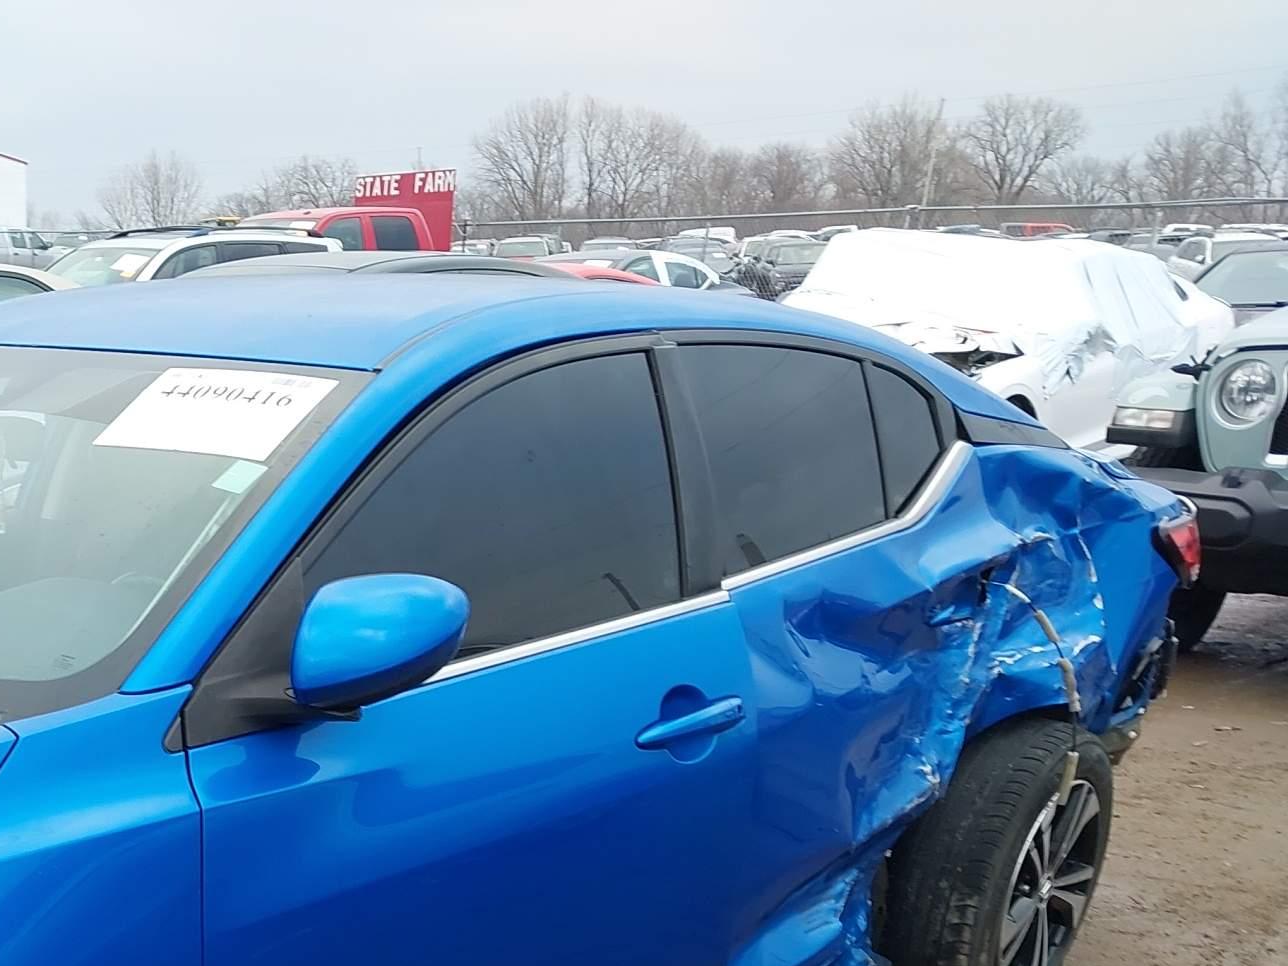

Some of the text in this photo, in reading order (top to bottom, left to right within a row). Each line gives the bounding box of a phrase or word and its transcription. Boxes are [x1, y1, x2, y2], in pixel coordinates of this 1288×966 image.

[355, 170, 455, 198] STATE FARM
[160, 384, 293, 408] 44090416
